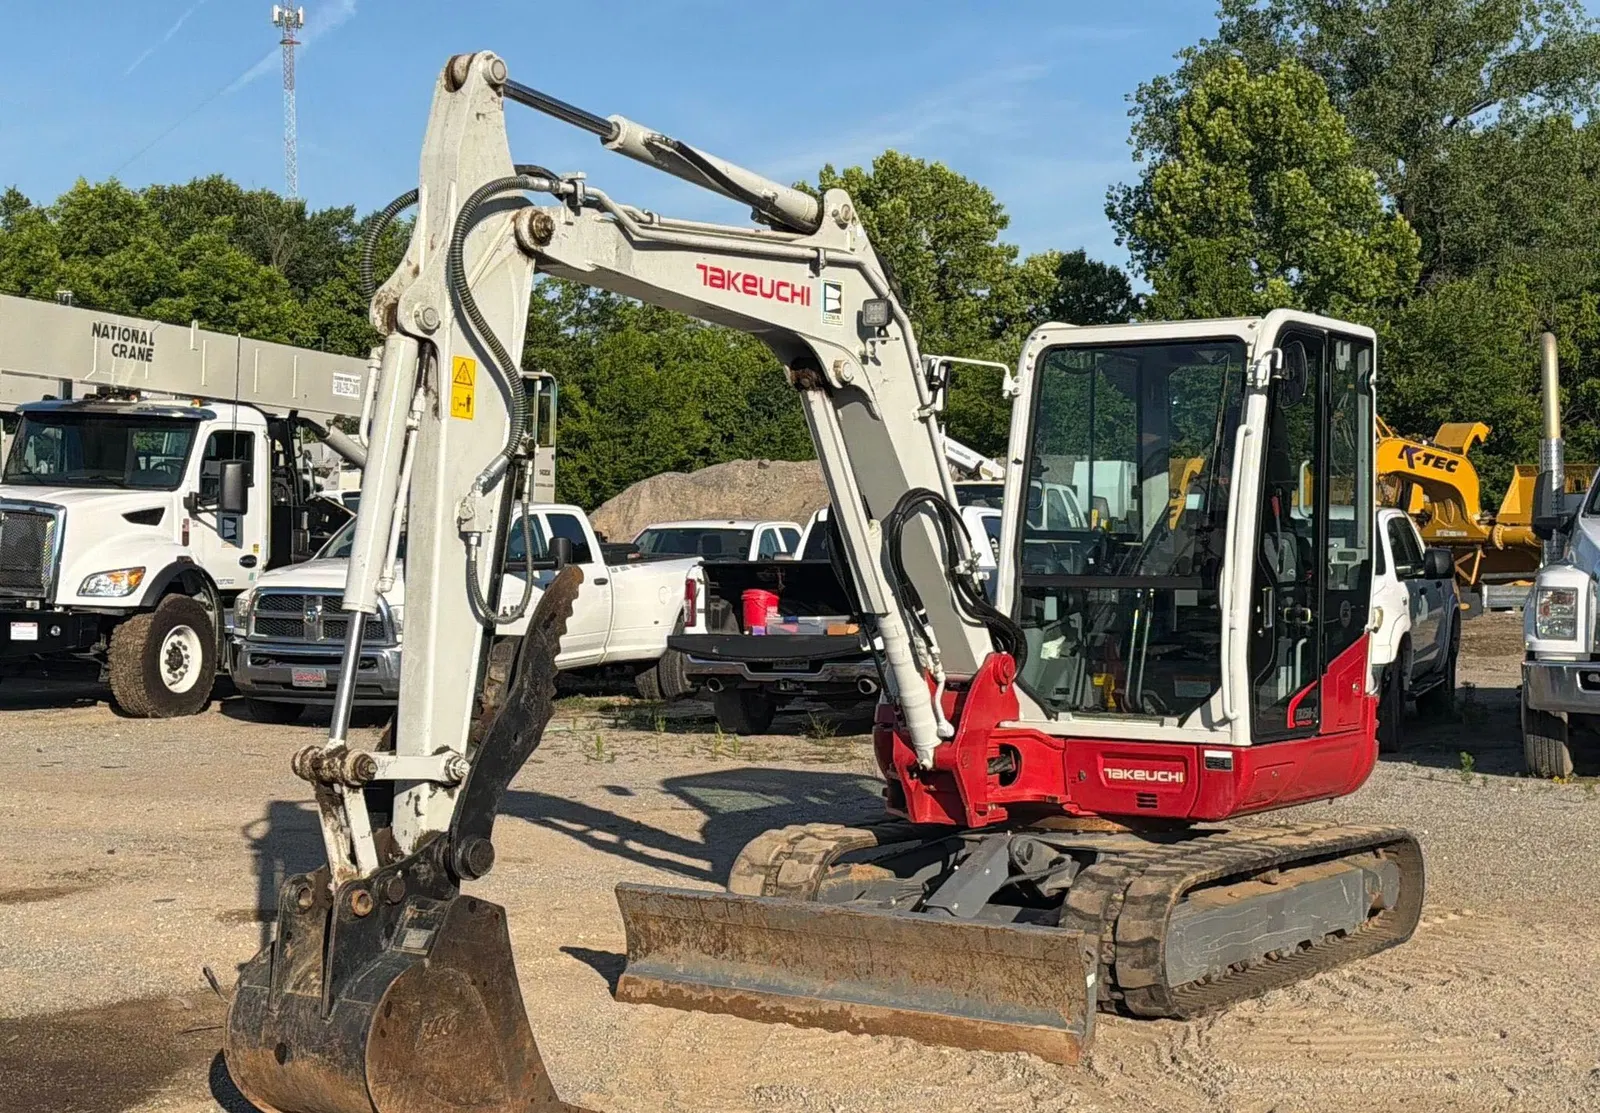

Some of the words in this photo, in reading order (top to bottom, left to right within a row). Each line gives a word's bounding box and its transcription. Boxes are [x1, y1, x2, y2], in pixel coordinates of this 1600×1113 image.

[91, 321, 155, 347] NATIONAL
[111, 342, 154, 363] CRANE
[1398, 445, 1459, 473] K-TEC
